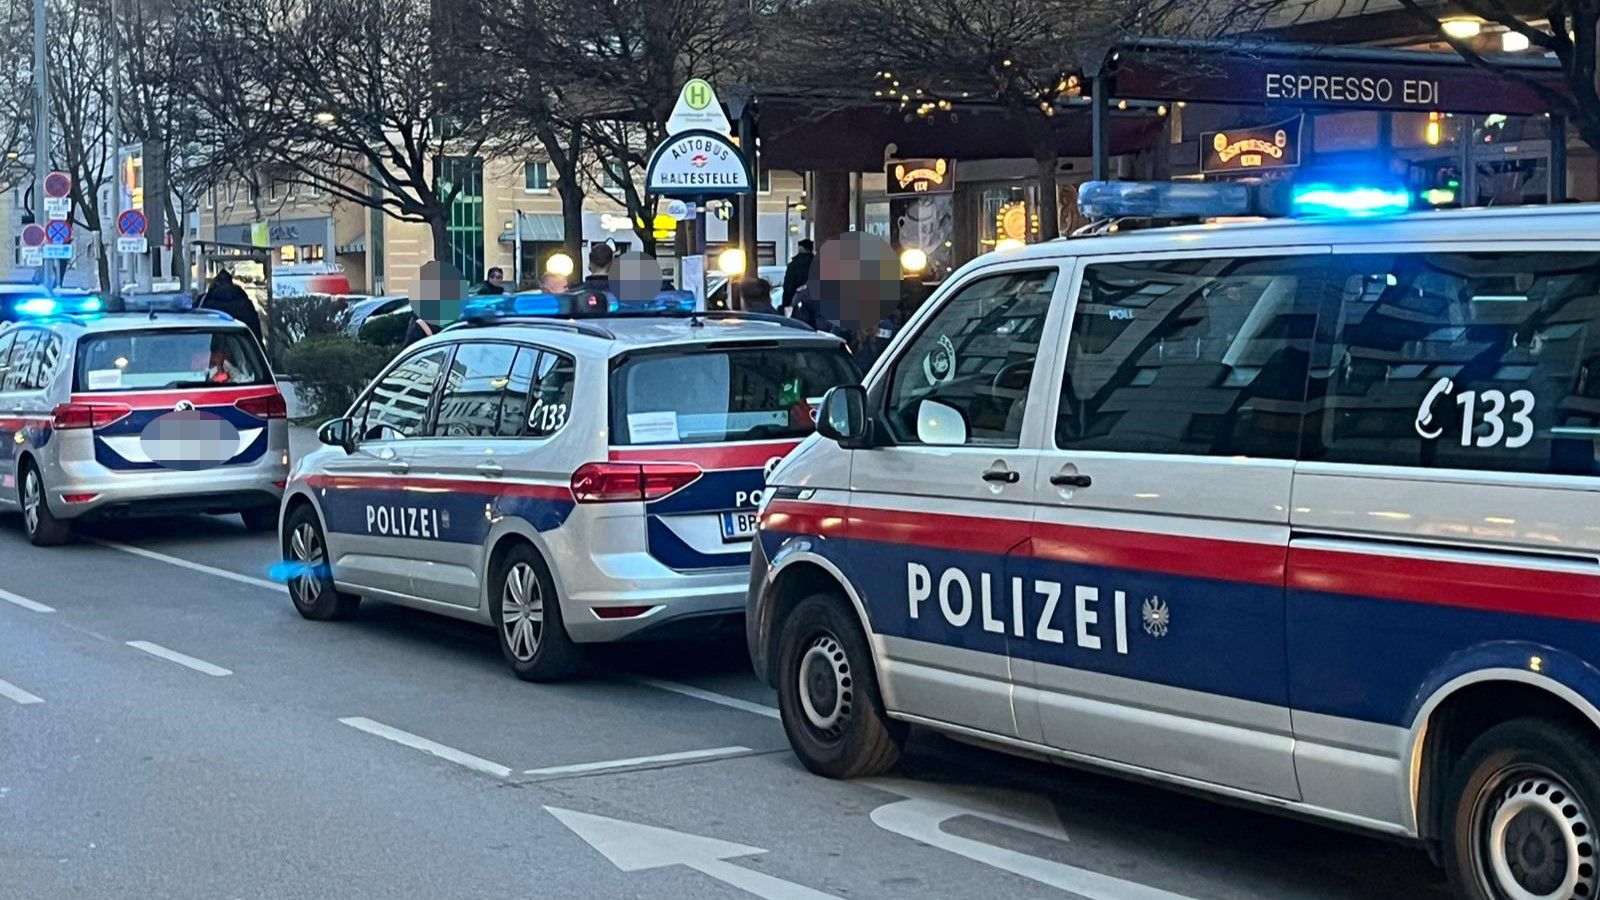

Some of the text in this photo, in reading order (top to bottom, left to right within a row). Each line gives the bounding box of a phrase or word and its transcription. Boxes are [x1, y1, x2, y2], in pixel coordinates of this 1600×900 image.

[691, 85, 705, 105] H
[1266, 73, 1438, 104] ESPRESSO EDI
[671, 139, 729, 161] AUTOBUS
[660, 172, 739, 184] HALTESTELLE
[541, 403, 567, 431] 133
[1456, 389, 1536, 448] 133
[366, 504, 439, 538] POLIZEI
[907, 561, 1128, 654] POLIZEI
